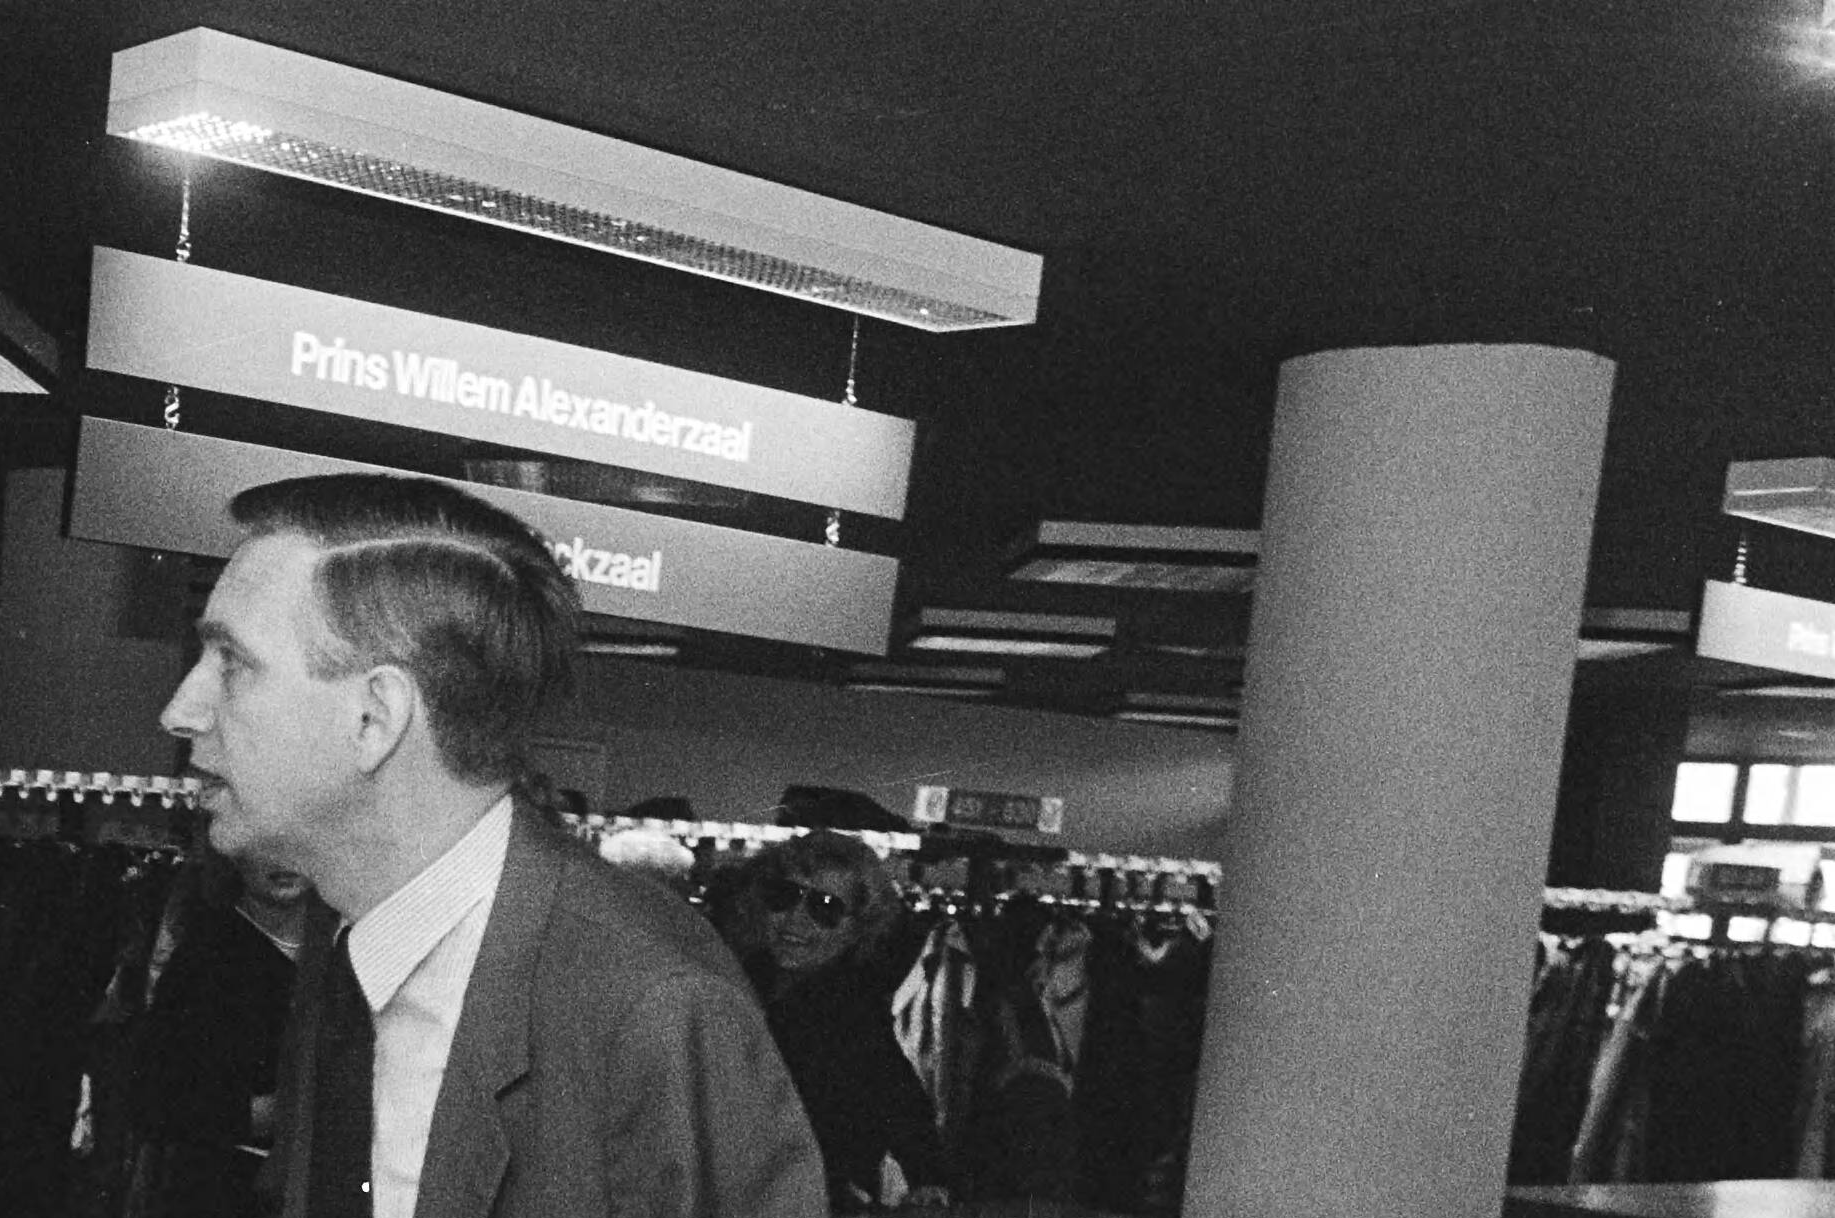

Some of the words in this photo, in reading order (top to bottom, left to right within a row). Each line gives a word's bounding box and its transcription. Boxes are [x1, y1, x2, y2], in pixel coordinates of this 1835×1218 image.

[291, 330, 389, 391] Prins
[391, 350, 511, 414] Willem
[512, 375, 753, 462] Alexanderzaal
[544, 537, 662, 593] ckzaal
